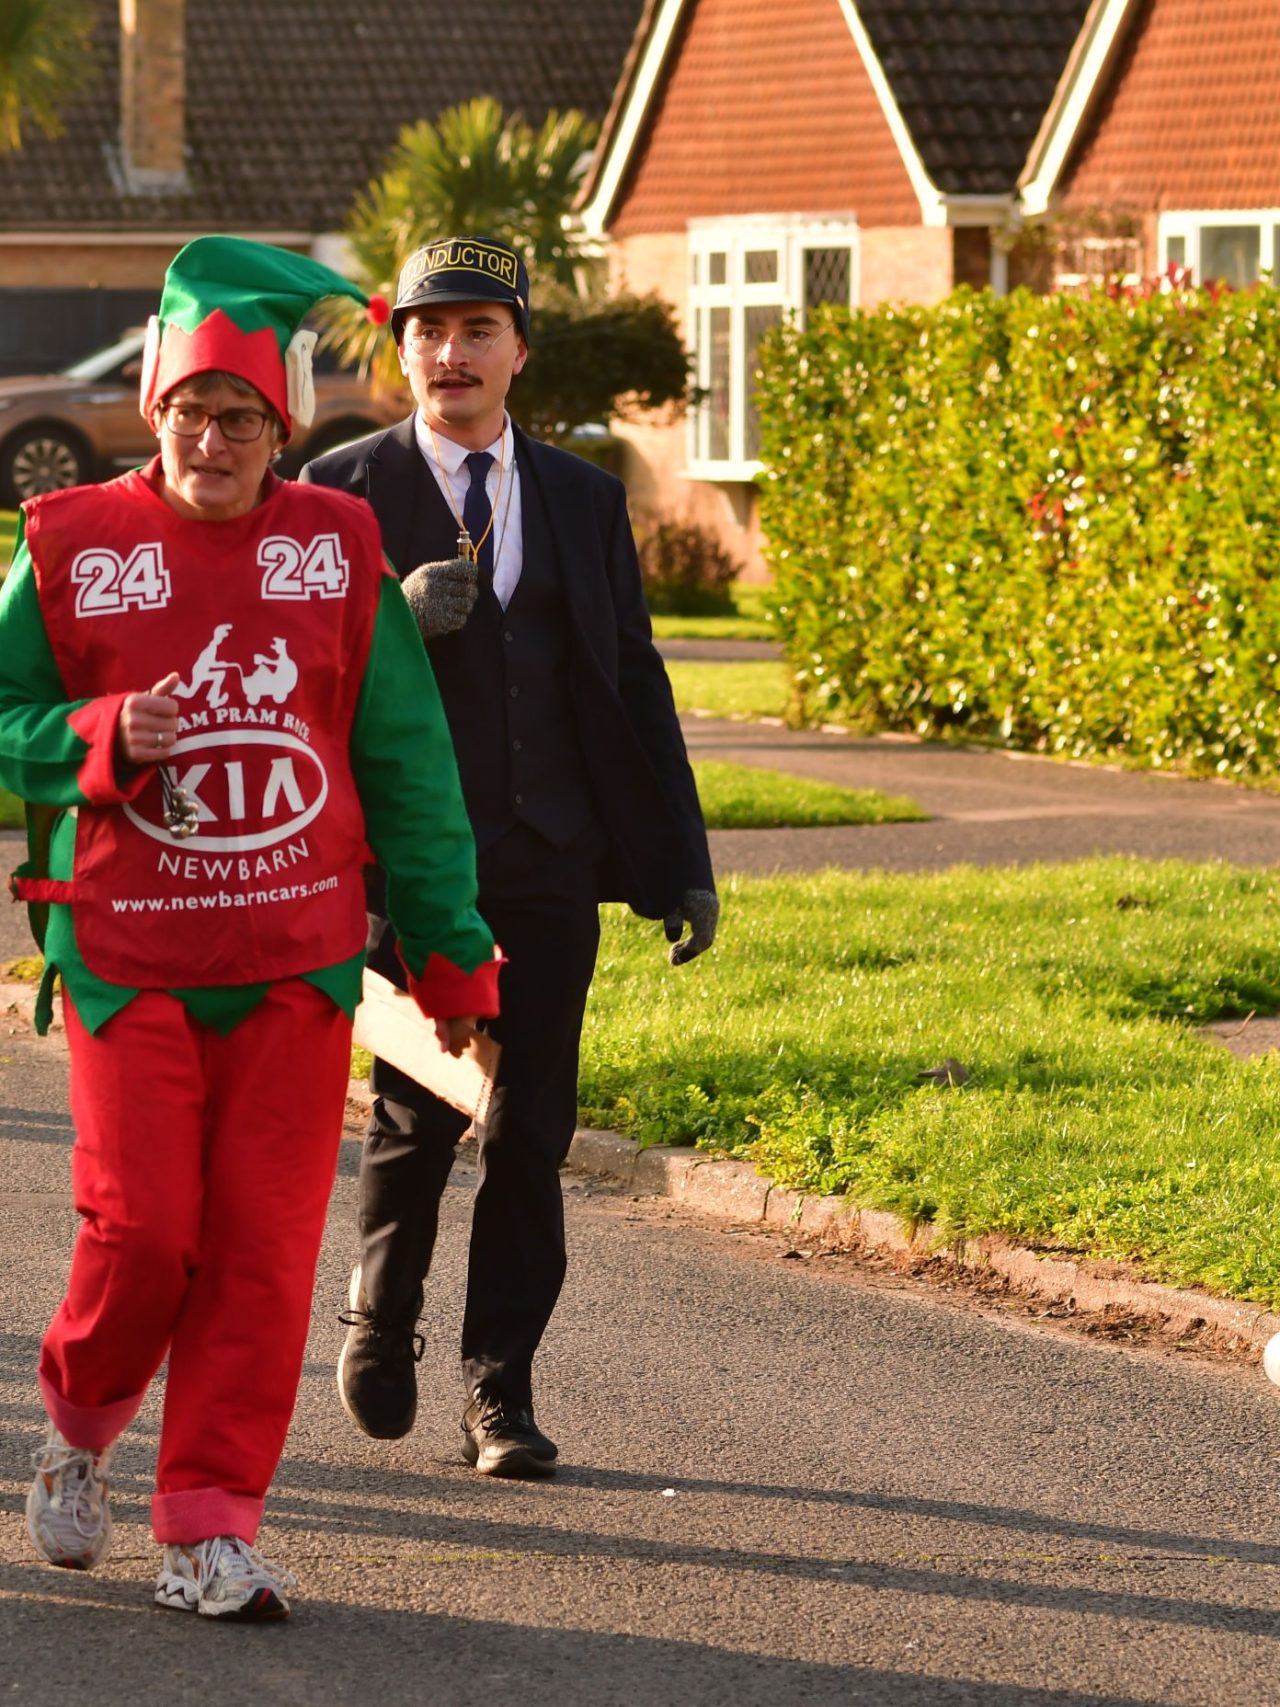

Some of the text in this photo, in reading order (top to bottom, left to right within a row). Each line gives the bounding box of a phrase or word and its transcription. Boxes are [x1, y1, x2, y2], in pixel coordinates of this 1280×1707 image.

[71, 541, 172, 619] 24
[256, 532, 350, 601] 24
[176, 710, 210, 733] AM
[215, 706, 278, 725] PRAM
[163, 756, 306, 823] KIA
[158, 837, 310, 881] NEWBARN
[112, 876, 338, 913] www.newbarncars.com
